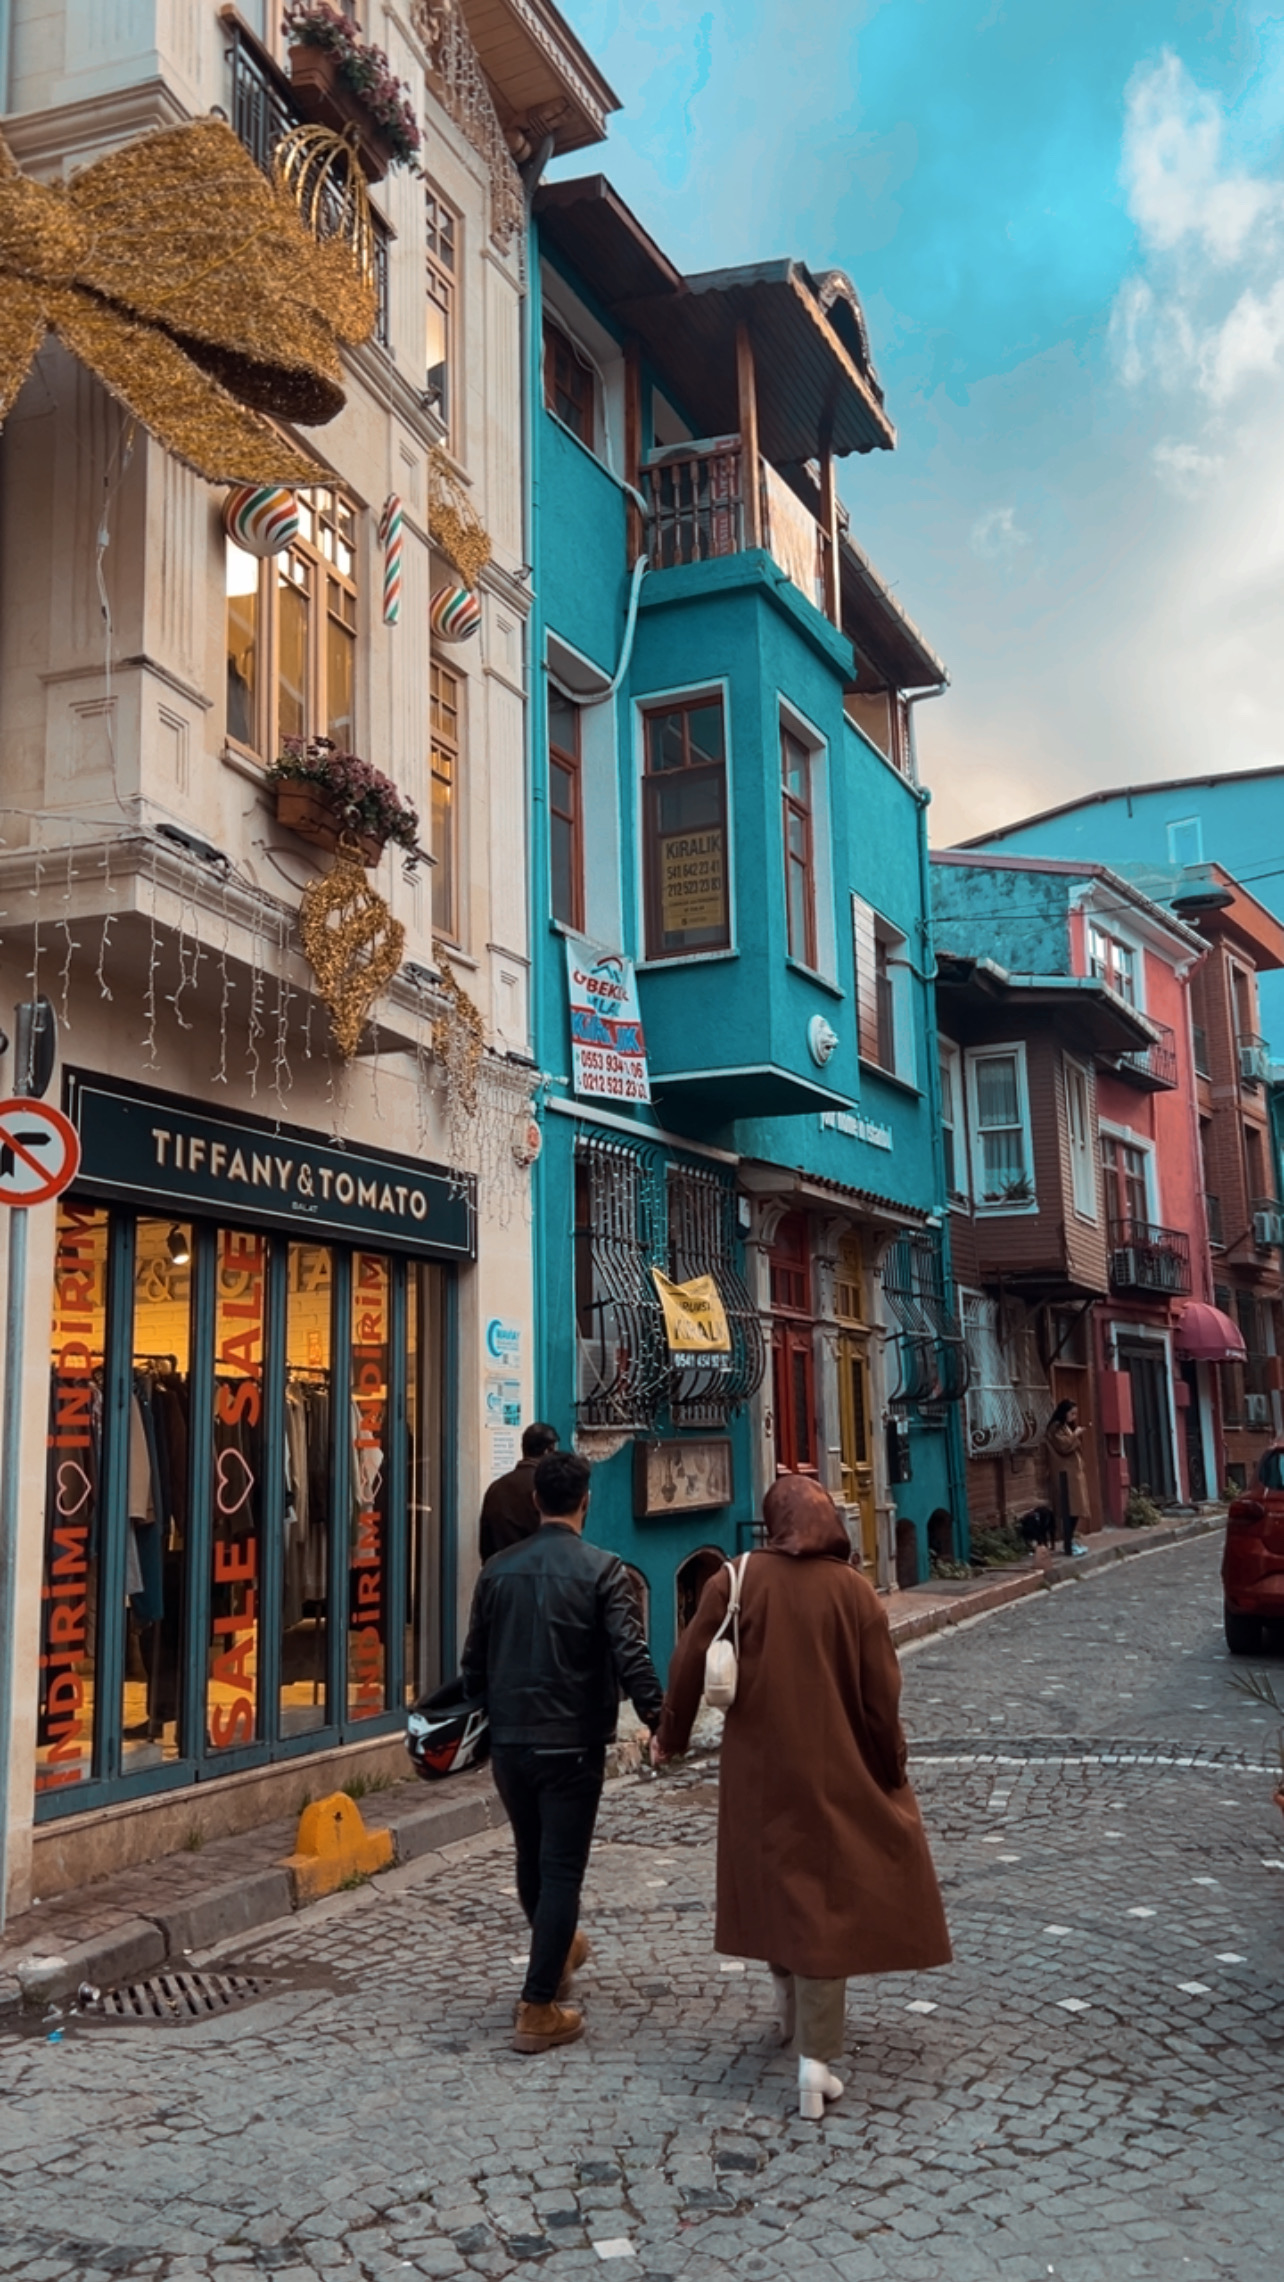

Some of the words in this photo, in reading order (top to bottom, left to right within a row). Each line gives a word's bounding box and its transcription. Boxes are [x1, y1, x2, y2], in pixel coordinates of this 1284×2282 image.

[581, 1050, 603, 1072] 0553
[582, 1072, 605, 1092] 0212
[219, 1231, 262, 1427] SALE
[211, 1538, 256, 1747] SALE
